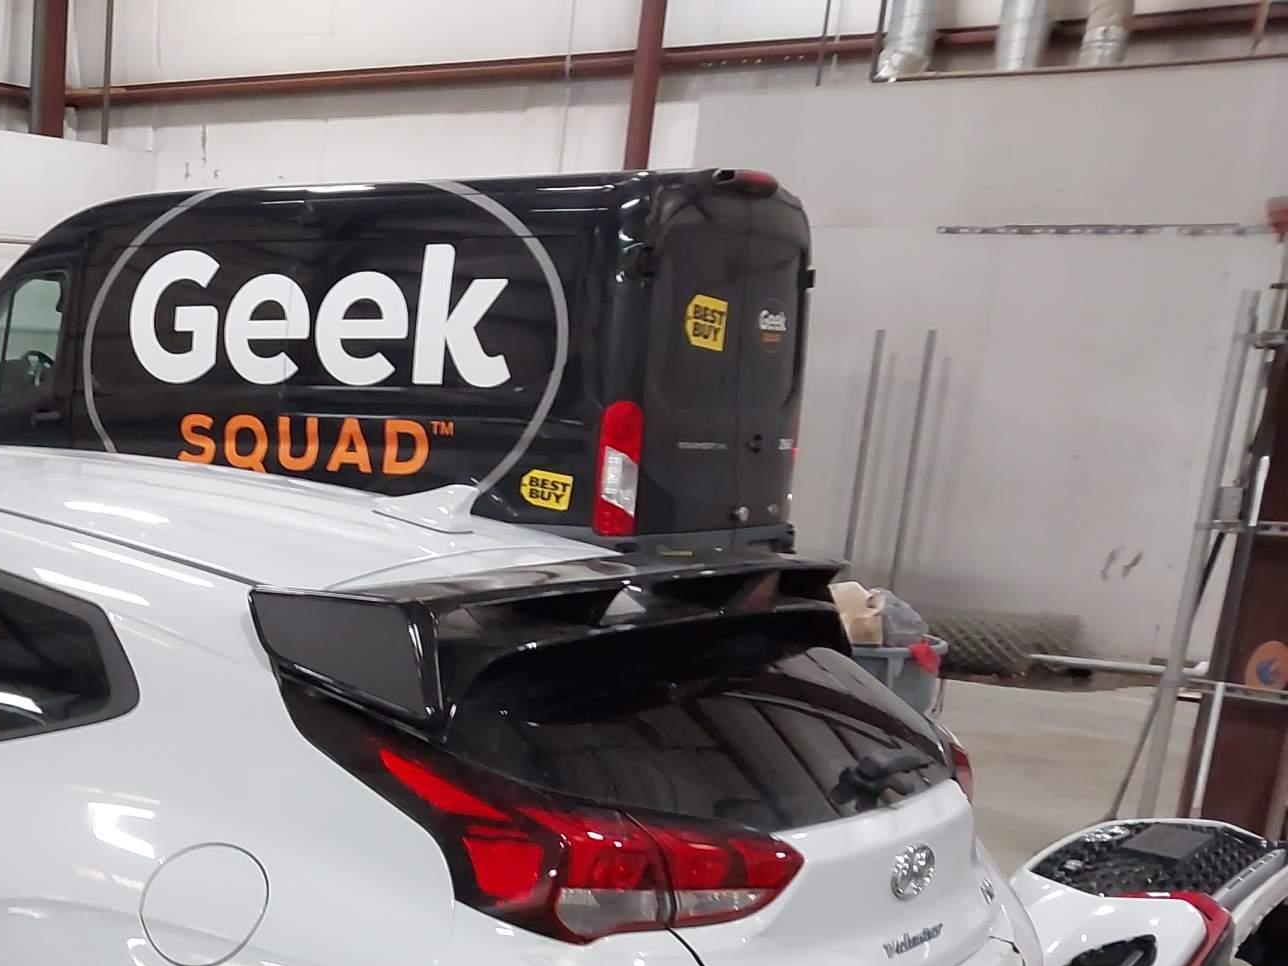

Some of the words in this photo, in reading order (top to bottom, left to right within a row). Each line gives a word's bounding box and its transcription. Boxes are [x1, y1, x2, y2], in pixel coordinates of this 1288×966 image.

[129, 243, 512, 389] Geek
[693, 303, 726, 327] BEST
[693, 321, 721, 342] BUY
[528, 475, 570, 493] BEST
[528, 487, 565, 504] BUY
